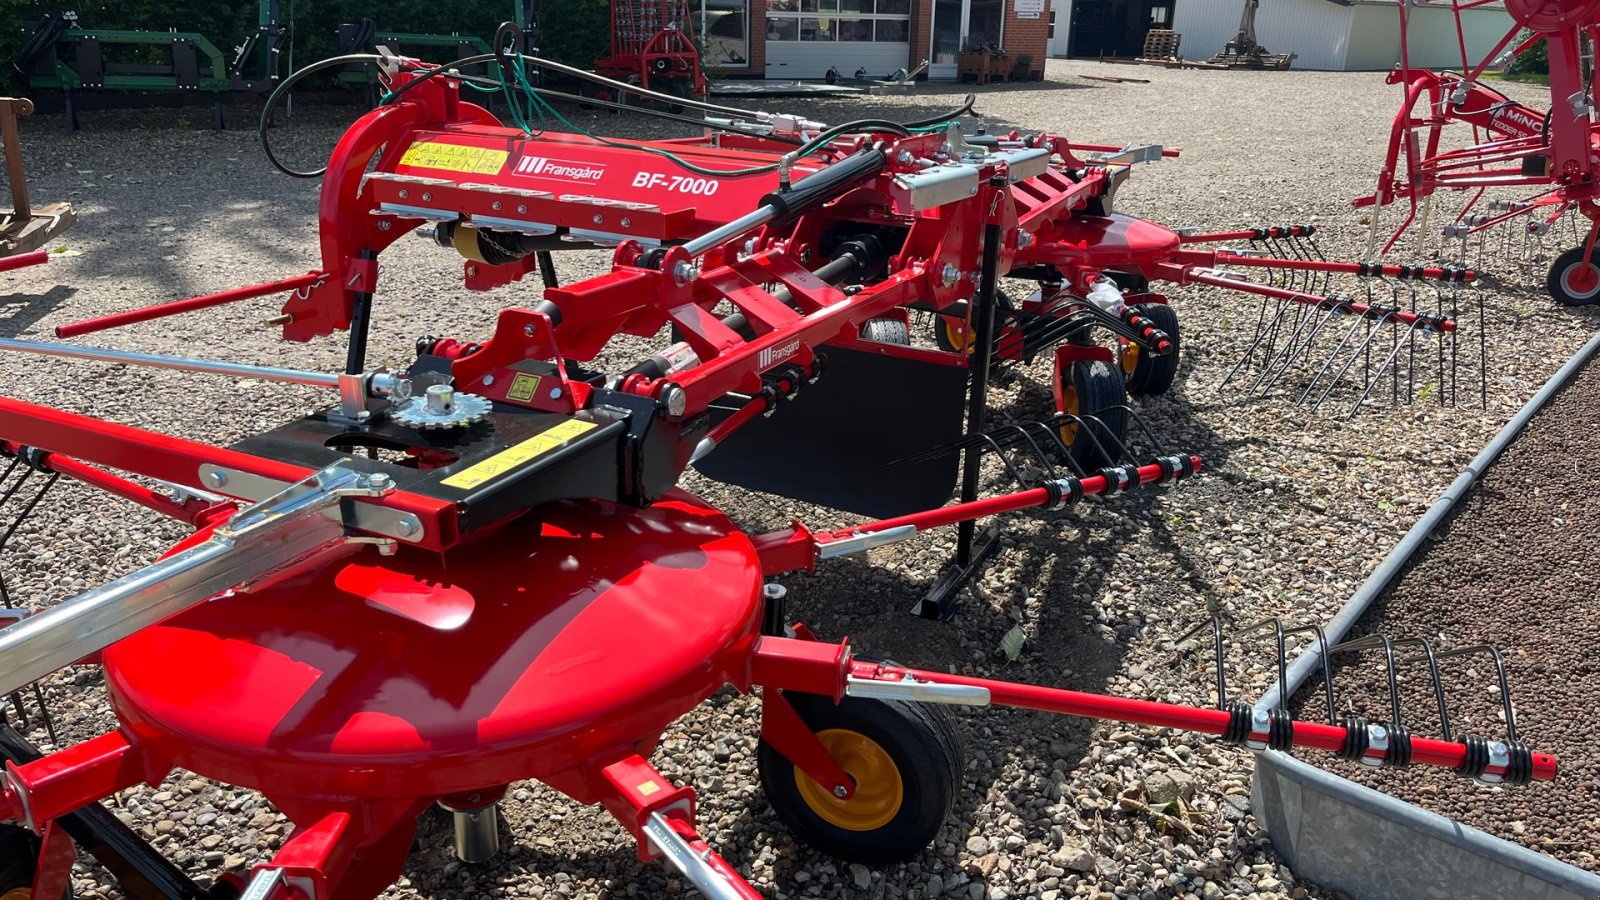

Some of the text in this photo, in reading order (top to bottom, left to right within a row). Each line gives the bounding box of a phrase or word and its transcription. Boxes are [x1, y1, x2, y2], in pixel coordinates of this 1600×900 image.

[1491, 118, 1518, 136] TEDDER
[543, 163, 605, 180] Fransgård
[632, 171, 719, 196] BF-7000
[772, 338, 800, 362] Fransgård
